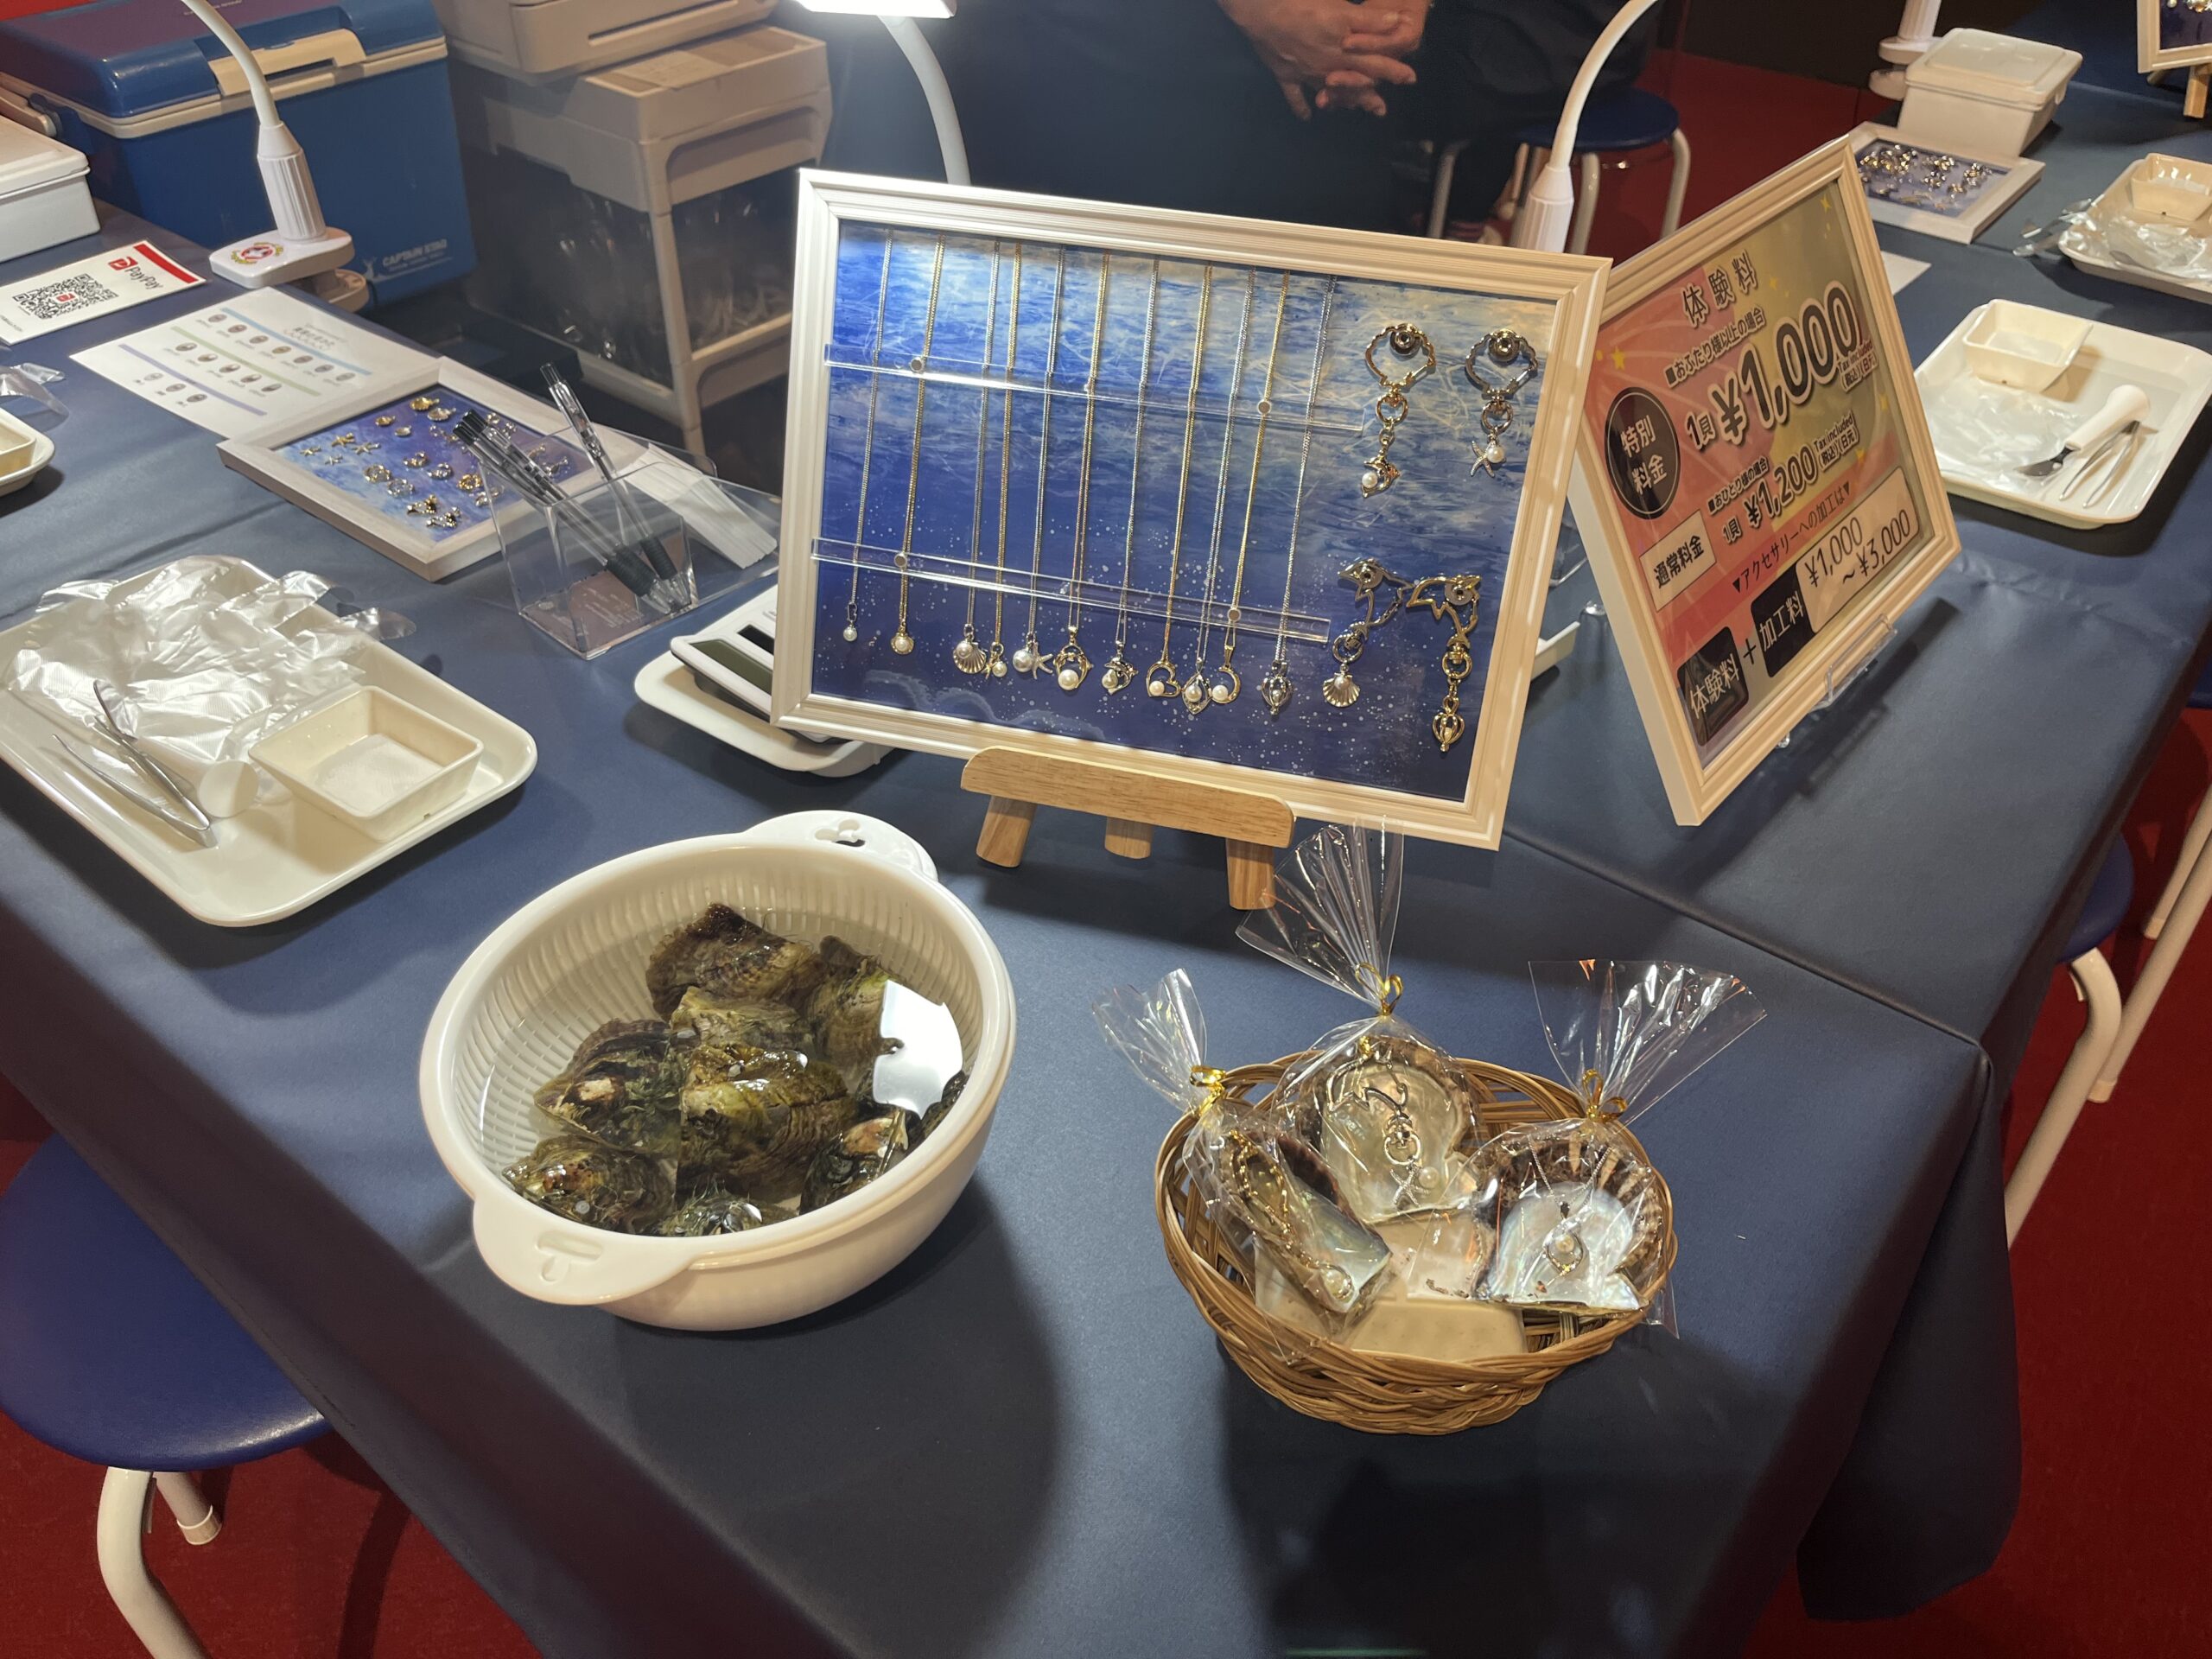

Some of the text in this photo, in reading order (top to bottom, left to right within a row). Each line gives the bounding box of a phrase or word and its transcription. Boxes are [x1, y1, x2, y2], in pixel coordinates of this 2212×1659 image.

[124, 265, 164, 290] PayPay
[1682, 251, 1756, 324] 体験料
[1710, 286, 1859, 436] ¥1,000
[1620, 414, 1656, 458] 特別
[1631, 454, 1668, 495] 料金
[1744, 446, 1815, 525] ¥1,200
[1653, 534, 1705, 589] 通常料金
[1804, 517, 1863, 588] ¥1,000
[1689, 652, 1740, 720] 体験料
[1758, 589, 1804, 652] 加工料
